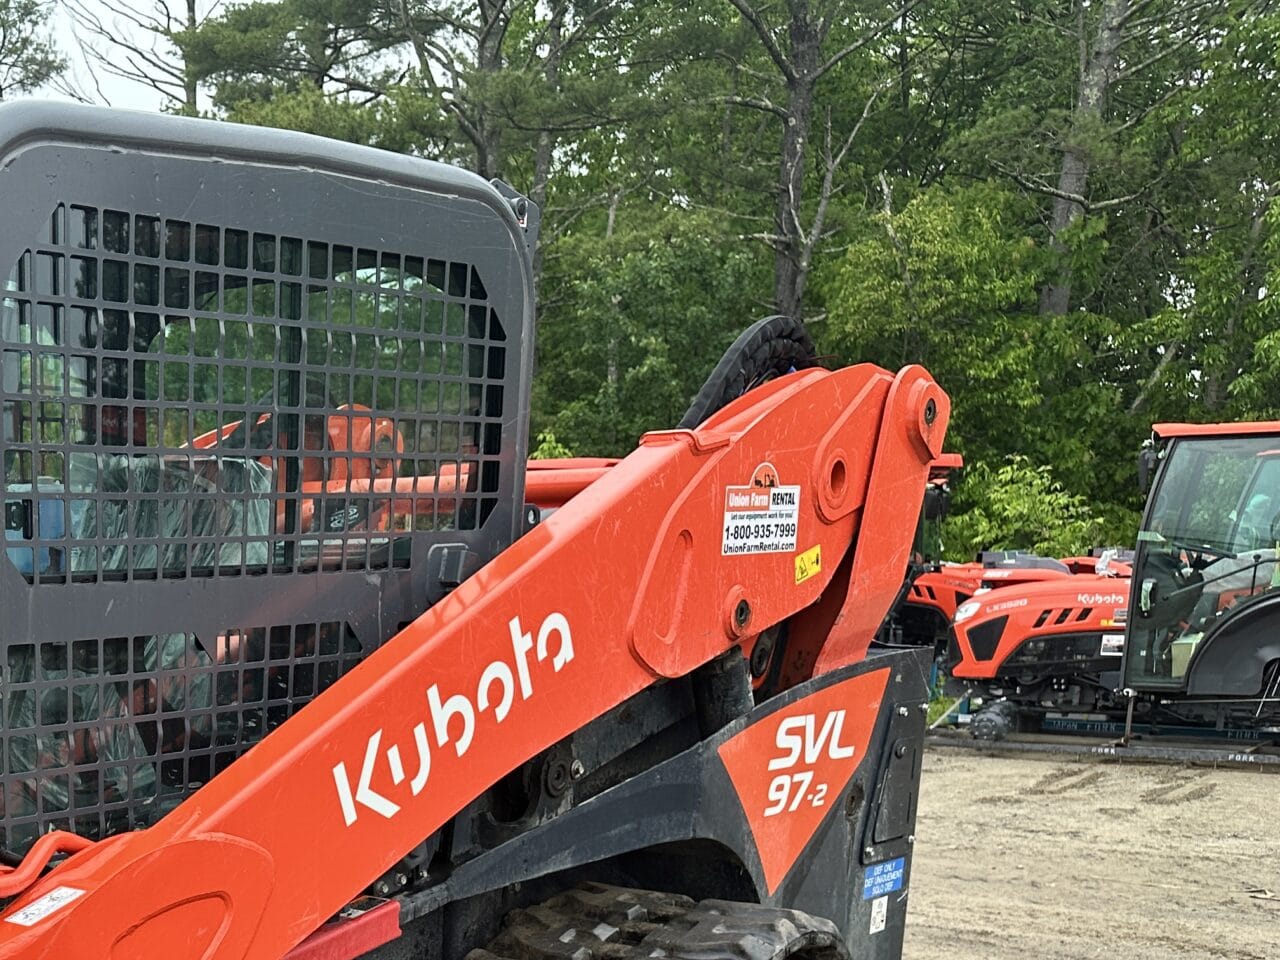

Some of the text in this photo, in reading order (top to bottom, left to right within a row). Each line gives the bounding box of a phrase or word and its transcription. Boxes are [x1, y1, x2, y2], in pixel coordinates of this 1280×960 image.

[729, 492, 796, 507] Union Farm RENTAL
[745, 511, 768, 521] equipment
[768, 511, 778, 519] work
[725, 523, 796, 540] 1-800-935-7999
[723, 541, 795, 554] UnionFarmRental.com
[1077, 593, 1124, 604] Kubota
[332, 612, 575, 827] Kubota
[768, 710, 855, 771] SVL
[1228, 753, 1255, 763] FORK
[763, 771, 828, 817] 97-2
